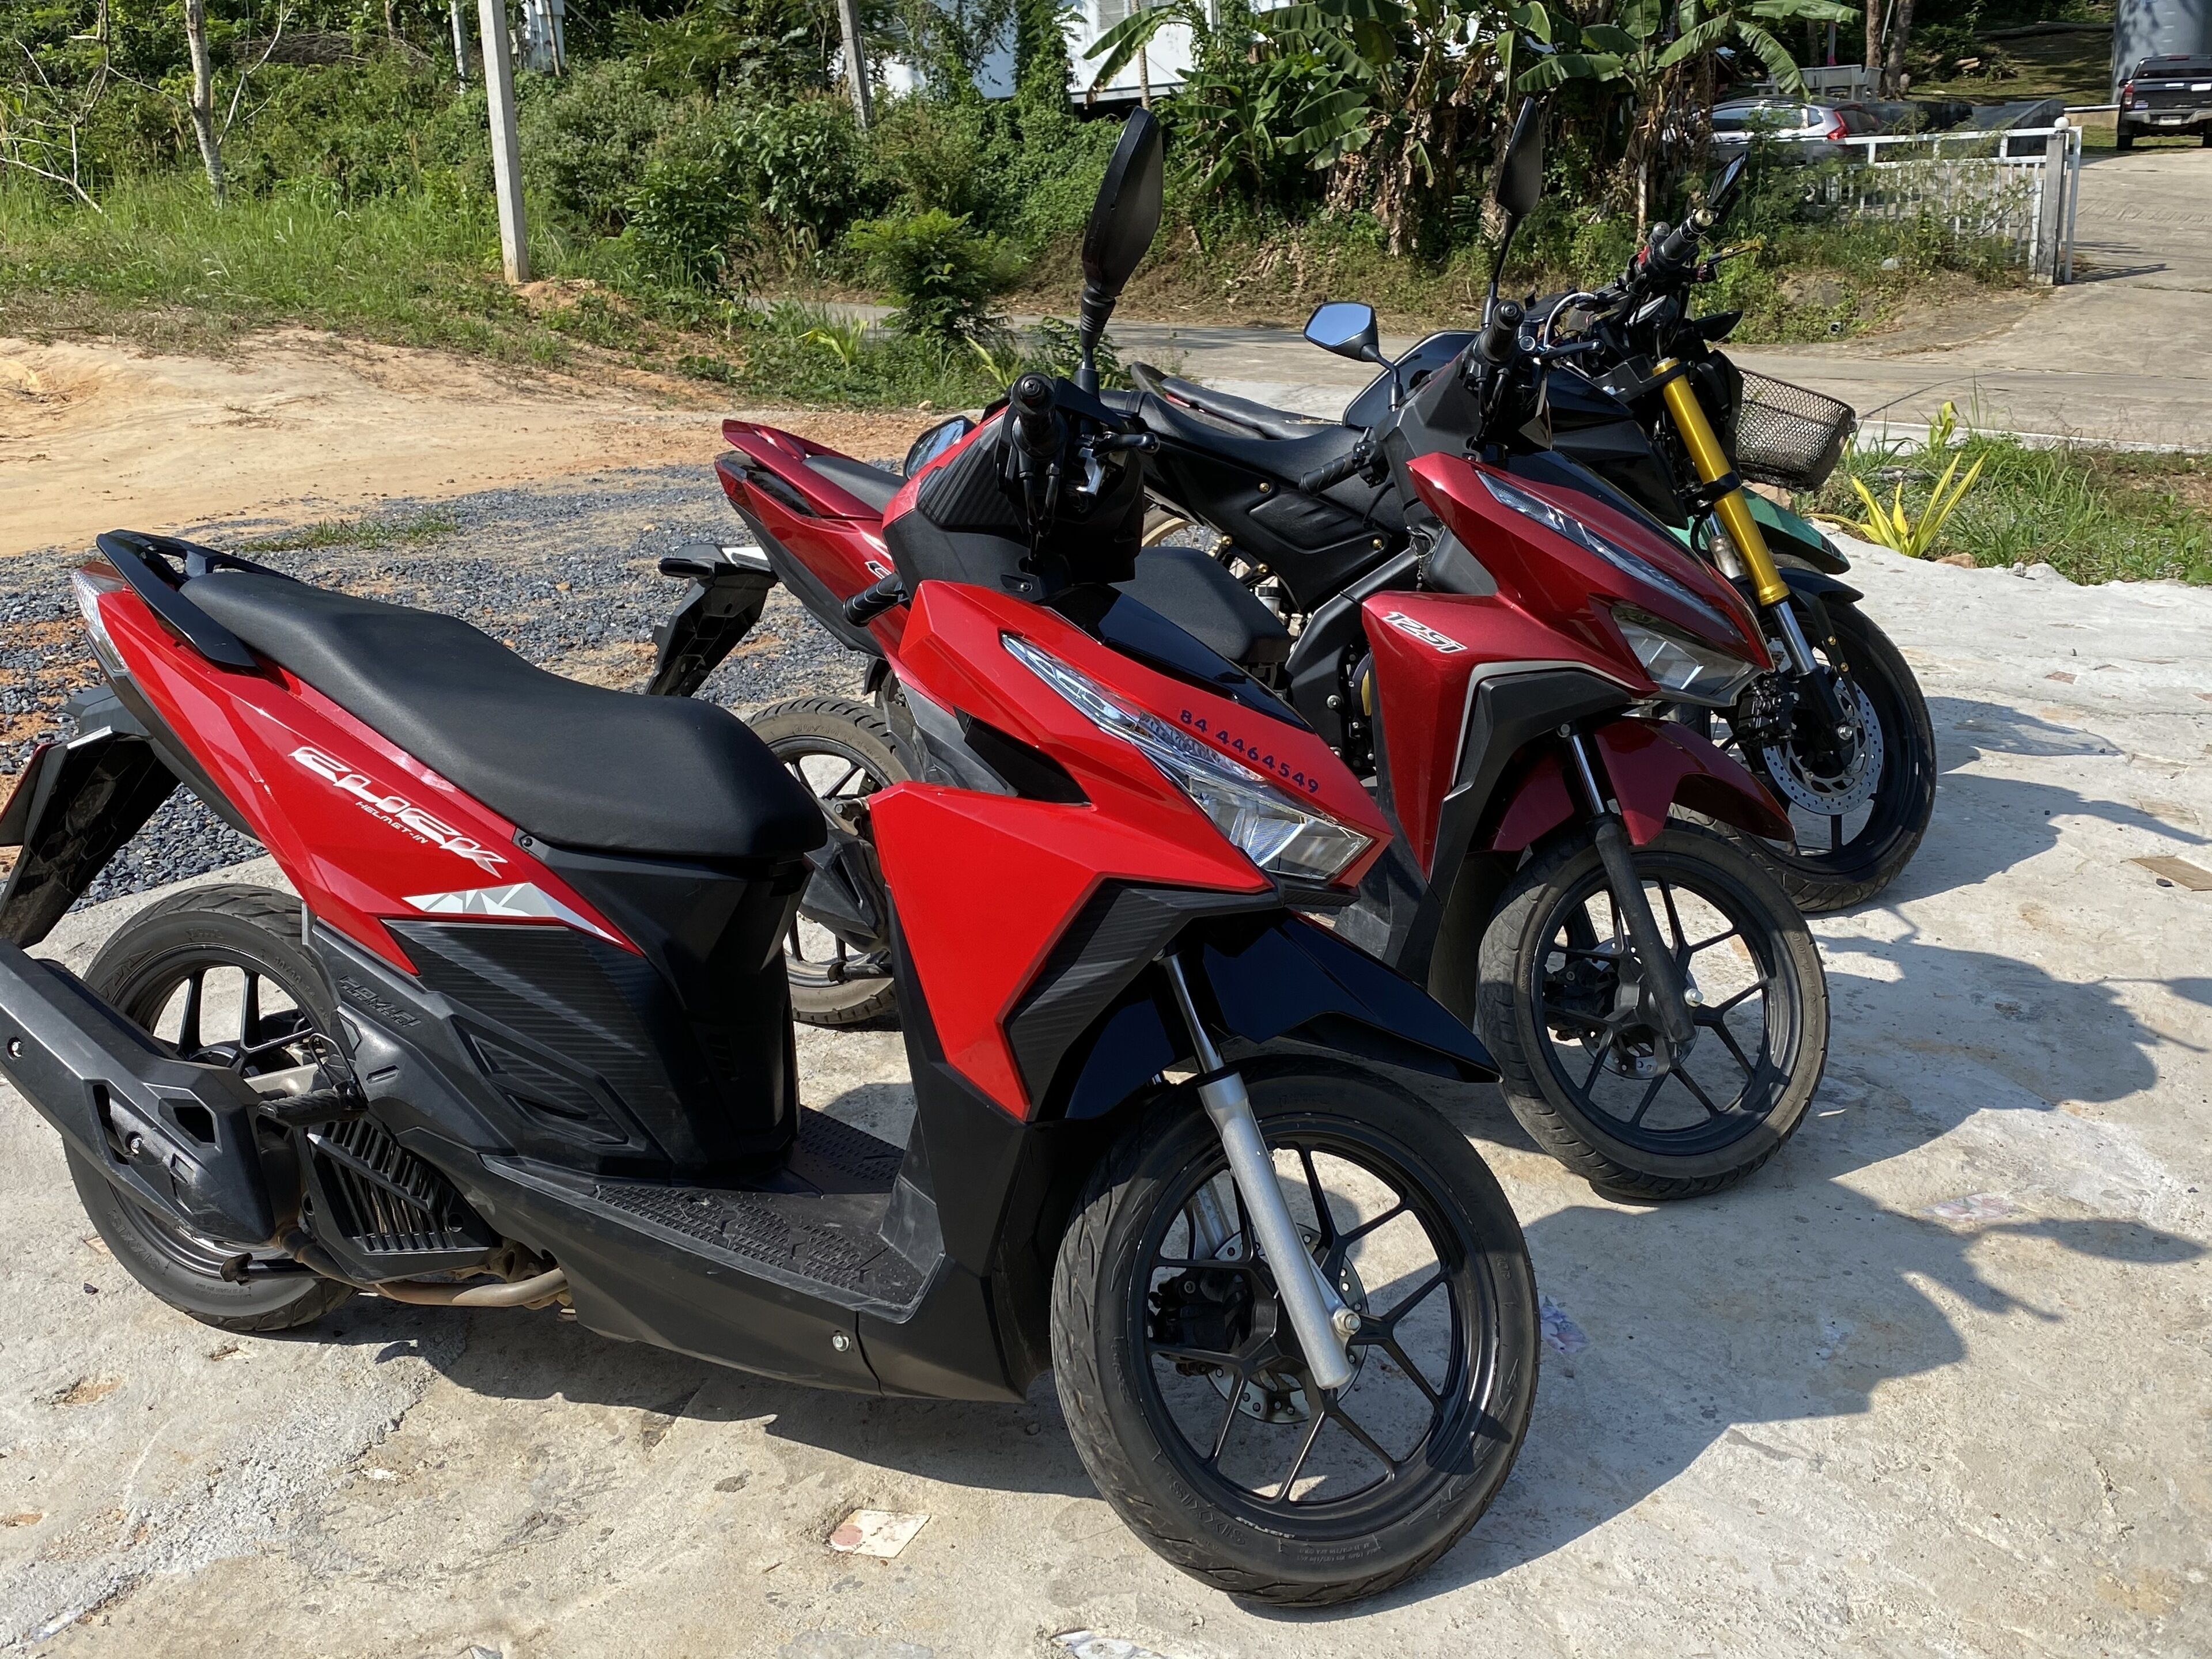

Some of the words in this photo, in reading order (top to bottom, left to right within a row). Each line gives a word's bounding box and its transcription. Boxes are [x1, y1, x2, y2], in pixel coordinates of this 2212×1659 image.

[1179, 709, 1208, 733] 84
[1215, 730, 1320, 794] 4464549
[355, 801, 429, 844] HELMET-IN
